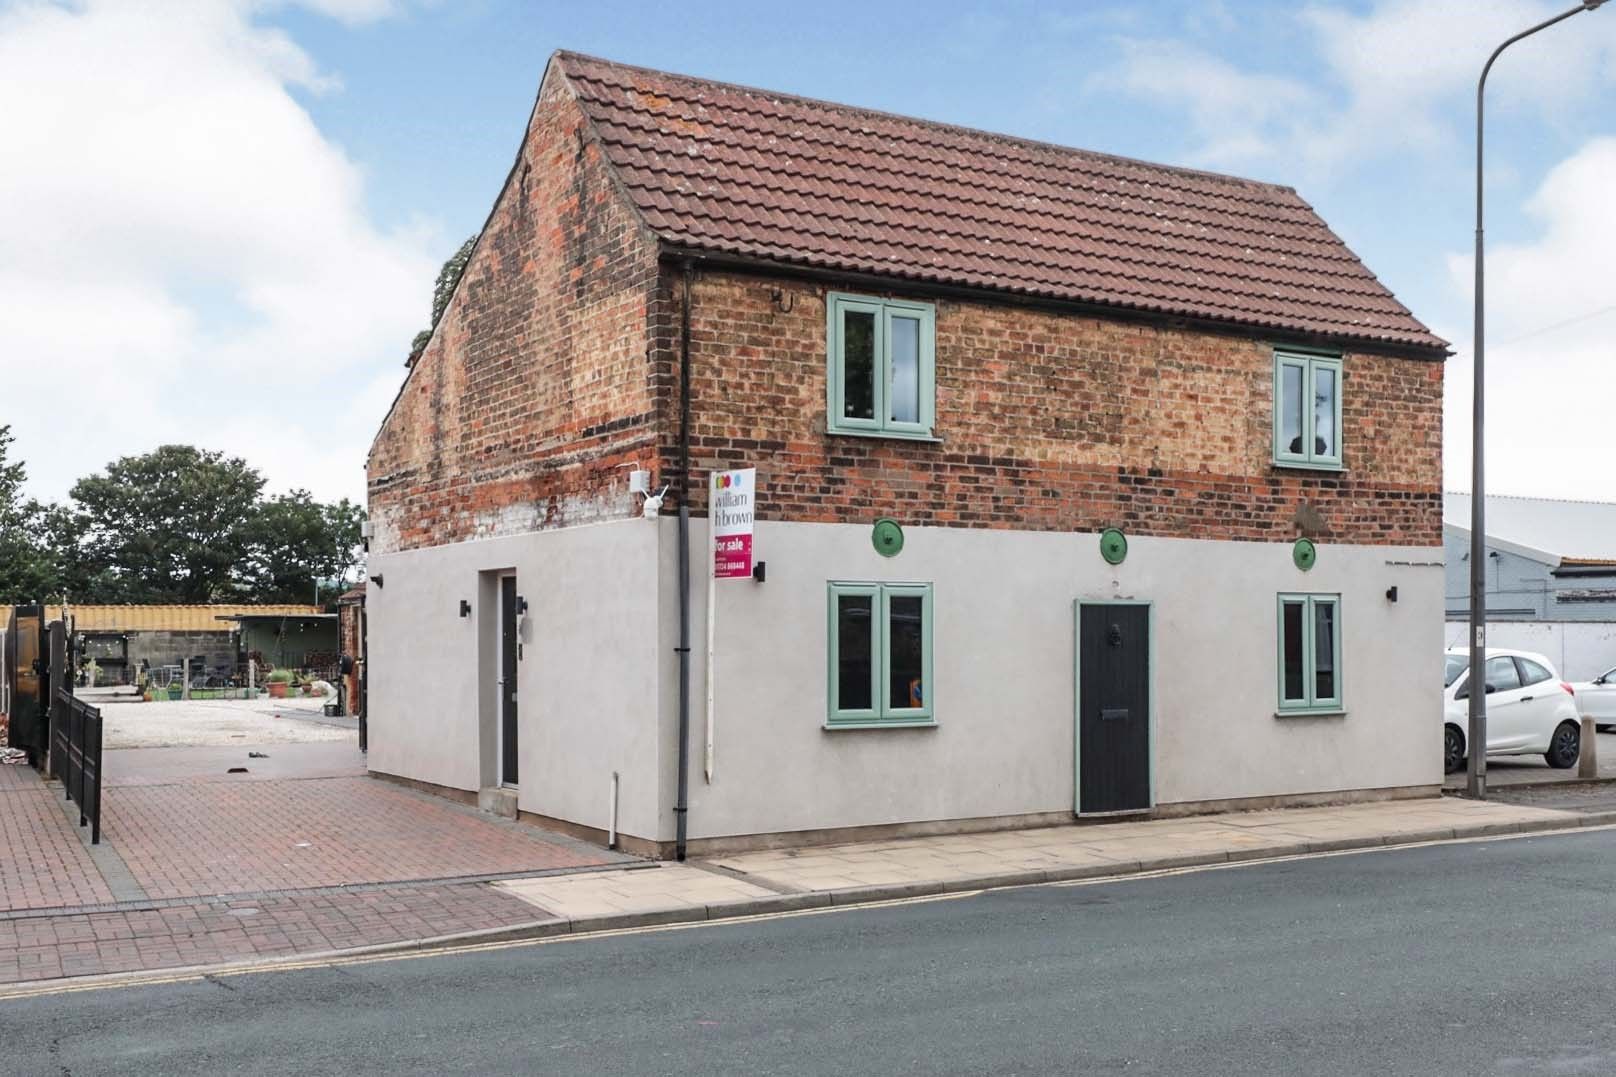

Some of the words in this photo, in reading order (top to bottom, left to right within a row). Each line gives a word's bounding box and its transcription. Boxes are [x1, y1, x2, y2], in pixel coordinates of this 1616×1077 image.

[715, 492, 747, 507] william
[722, 509, 752, 526] brown
[727, 537, 743, 551] sale
